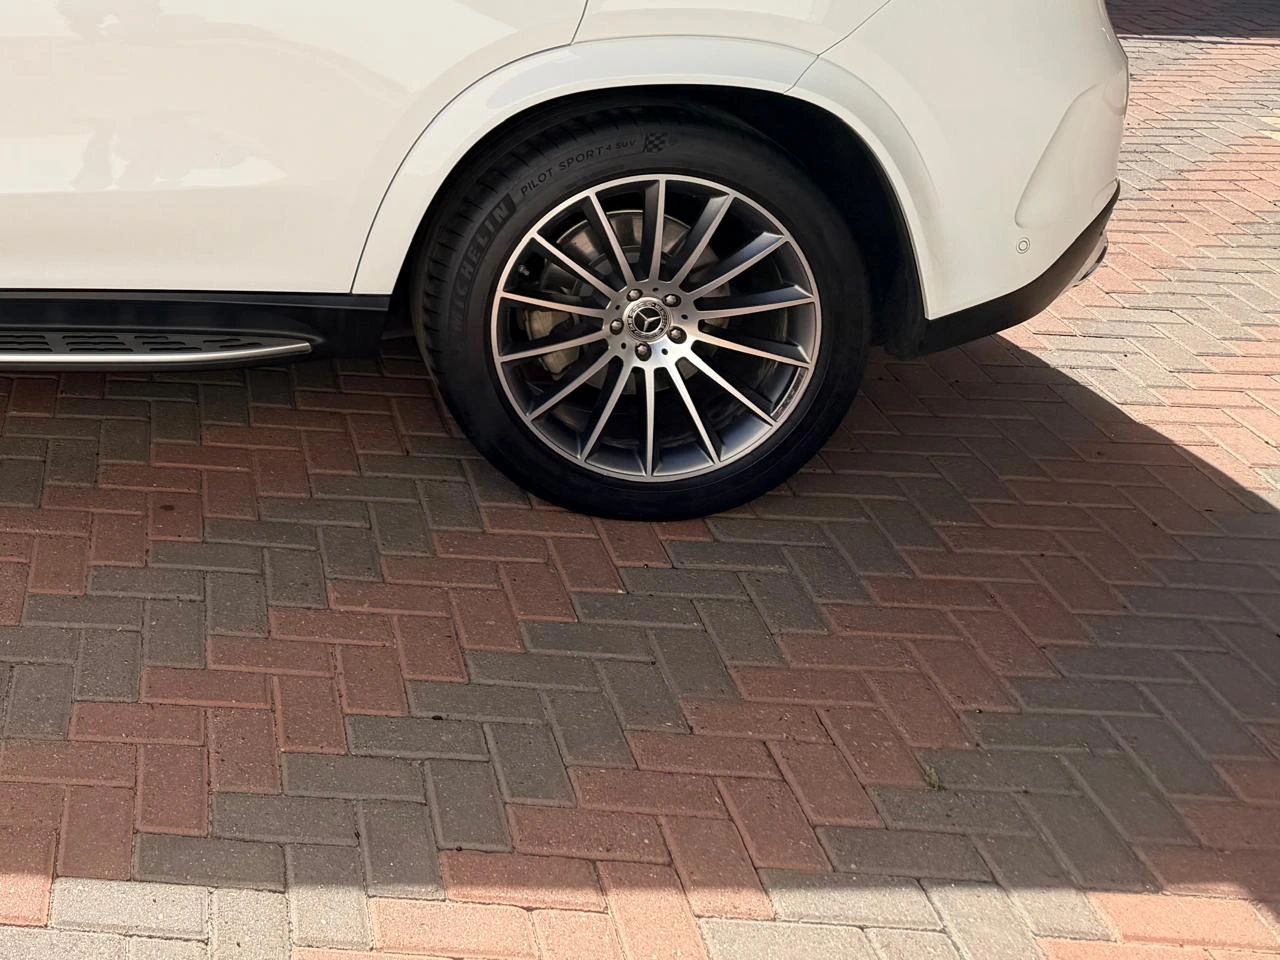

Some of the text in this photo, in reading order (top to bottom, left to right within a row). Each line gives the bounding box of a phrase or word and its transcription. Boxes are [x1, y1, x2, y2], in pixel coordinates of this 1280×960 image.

[520, 168, 554, 196] PILOT
[558, 147, 605, 172] SPORT
[615, 139, 637, 150] SUV
